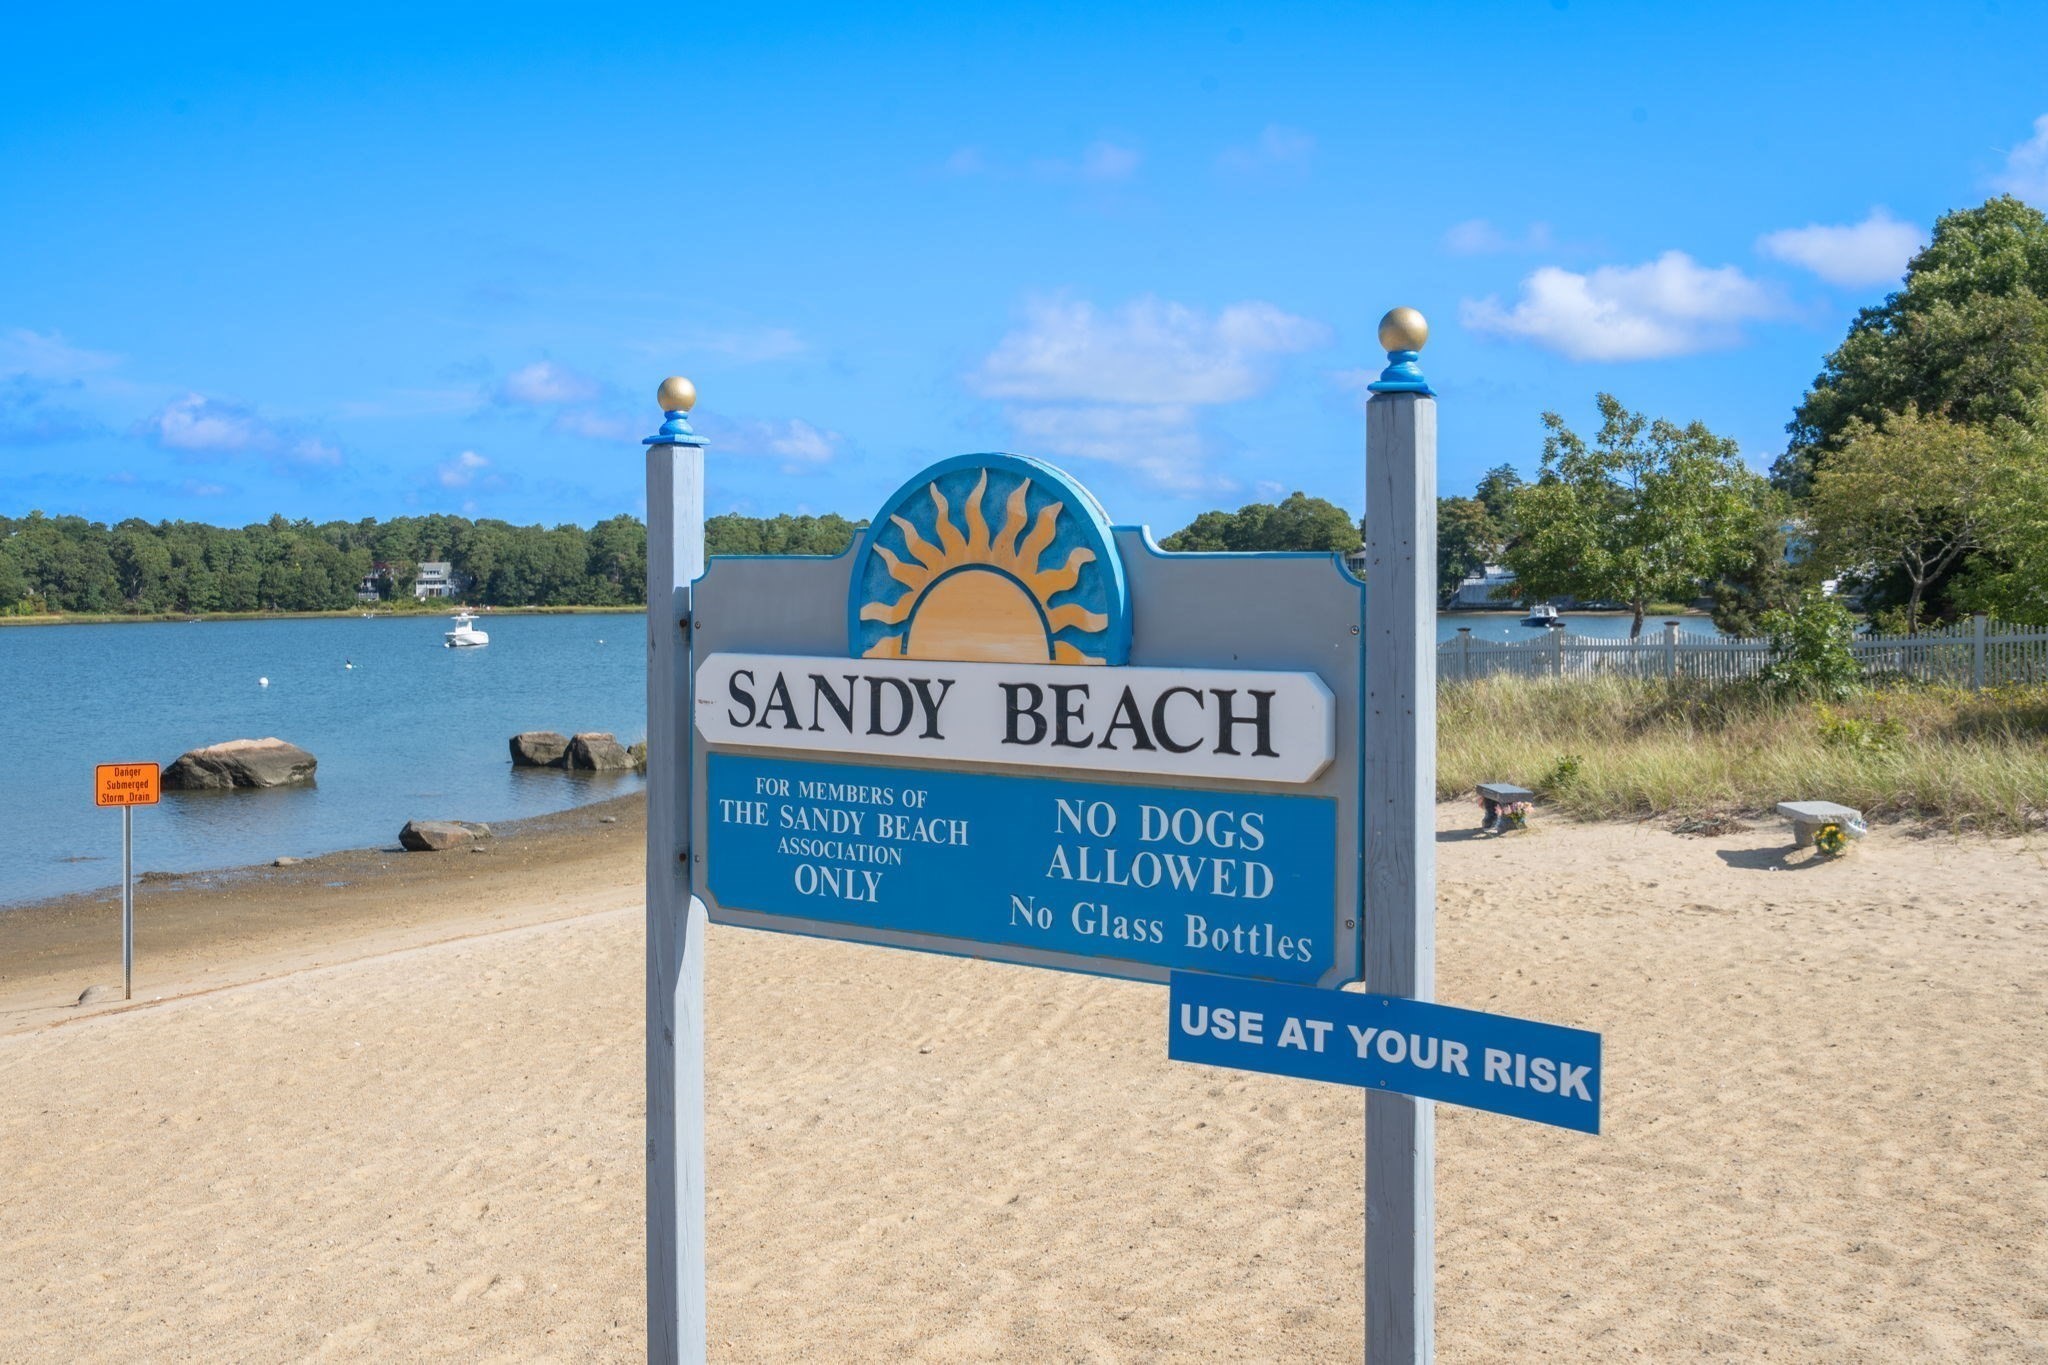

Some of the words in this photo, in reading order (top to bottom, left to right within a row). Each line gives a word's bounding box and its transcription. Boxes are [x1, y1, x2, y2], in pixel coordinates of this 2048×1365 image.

[727, 669, 956, 740] SANDY
[998, 682, 1280, 758] BEACH
[106, 779, 149, 791] Submerged
[114, 767, 141, 778] Danger
[755, 777, 790, 797] FOR
[799, 781, 894, 805] MEMBERS
[902, 787, 928, 809] OF
[102, 793, 124, 803] Storm
[129, 792, 150, 801] Drain
[719, 798, 770, 827] THE
[780, 805, 866, 836] SANDY
[876, 813, 969, 847] BEACH
[1054, 797, 1118, 838] NO
[1138, 804, 1265, 851] DOGS
[777, 837, 903, 866] ASSOCIATION
[1046, 845, 1274, 899] ALLOWED
[793, 863, 883, 903] ONLY
[1009, 894, 1053, 930] No
[1071, 902, 1163, 944] Glass
[1184, 913, 1313, 963] Bottles
[1180, 1003, 1264, 1045] USE
[1277, 1017, 1334, 1053] AT
[1347, 1025, 1469, 1077] YOUR
[1484, 1047, 1592, 1102] RISK
